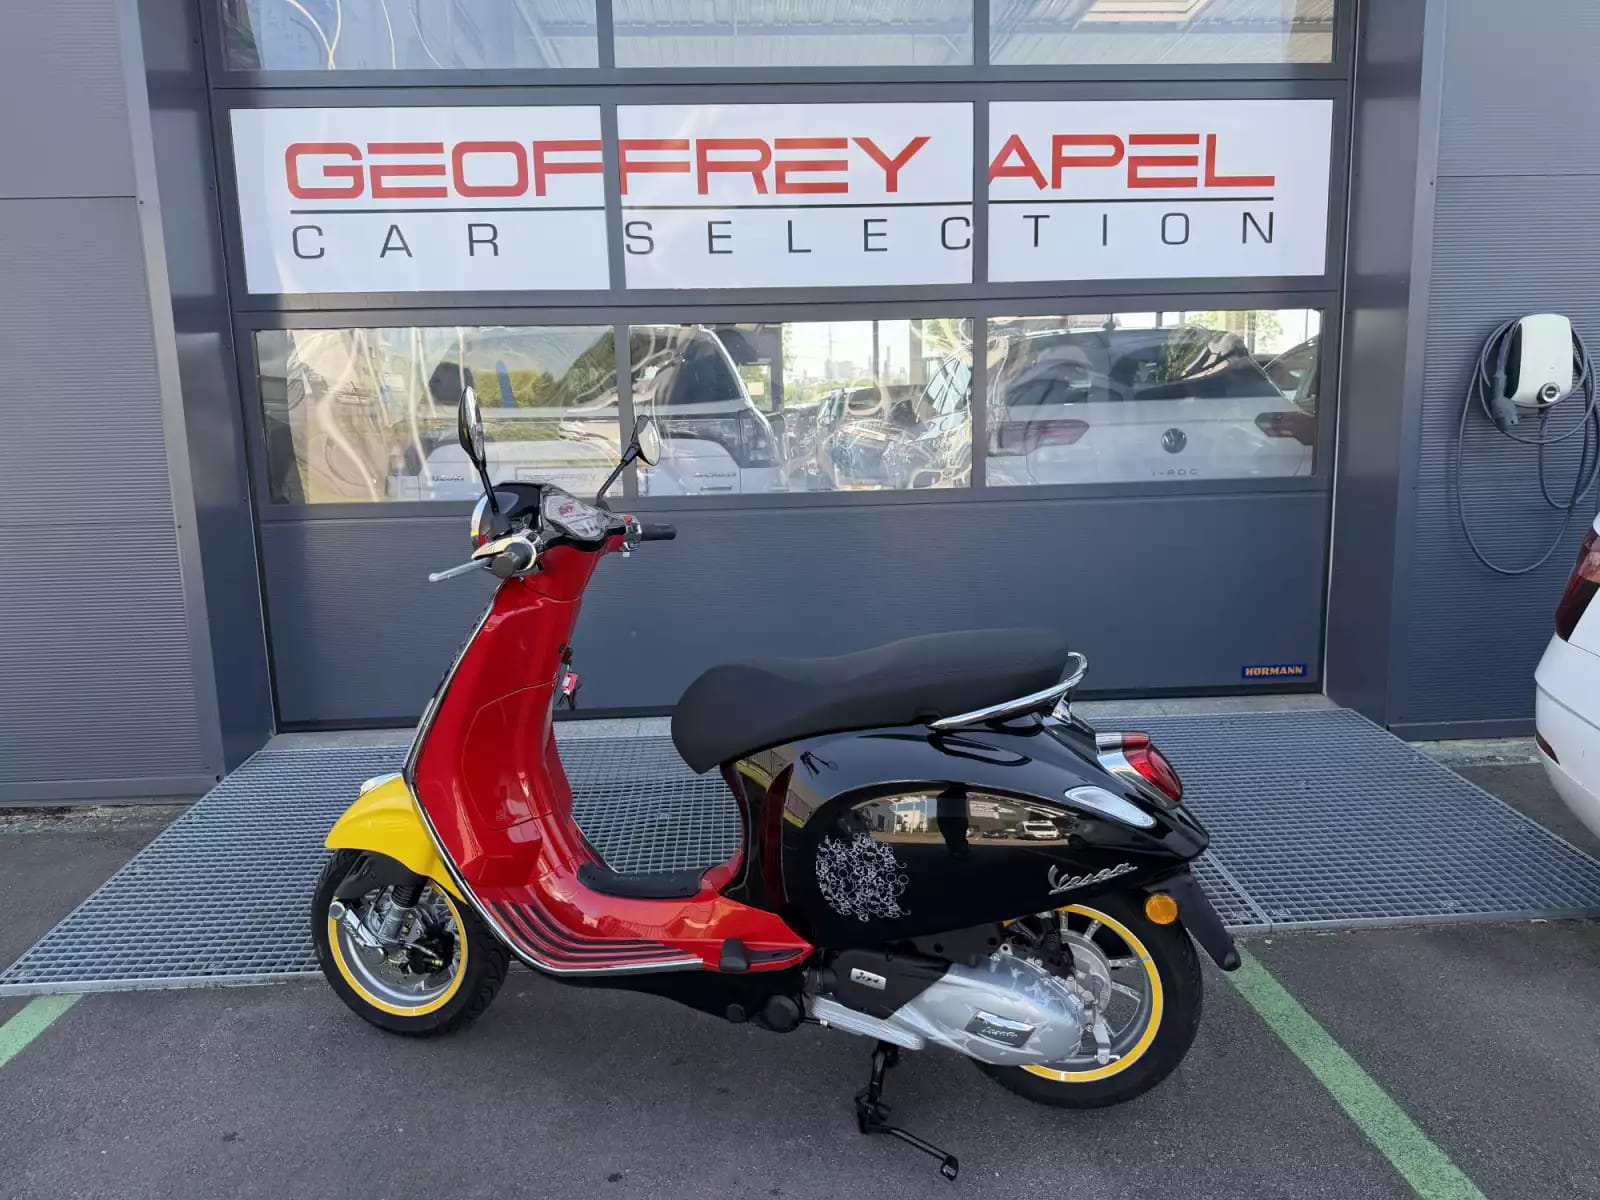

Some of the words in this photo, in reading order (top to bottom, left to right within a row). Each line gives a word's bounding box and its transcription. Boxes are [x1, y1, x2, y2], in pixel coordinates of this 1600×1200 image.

[285, 137, 931, 200] GEOFFREY
[988, 132, 1276, 192] APEL
[291, 223, 500, 260] CAR
[624, 211, 1275, 256] SELECTION
[1047, 861, 1139, 896] Vespa
